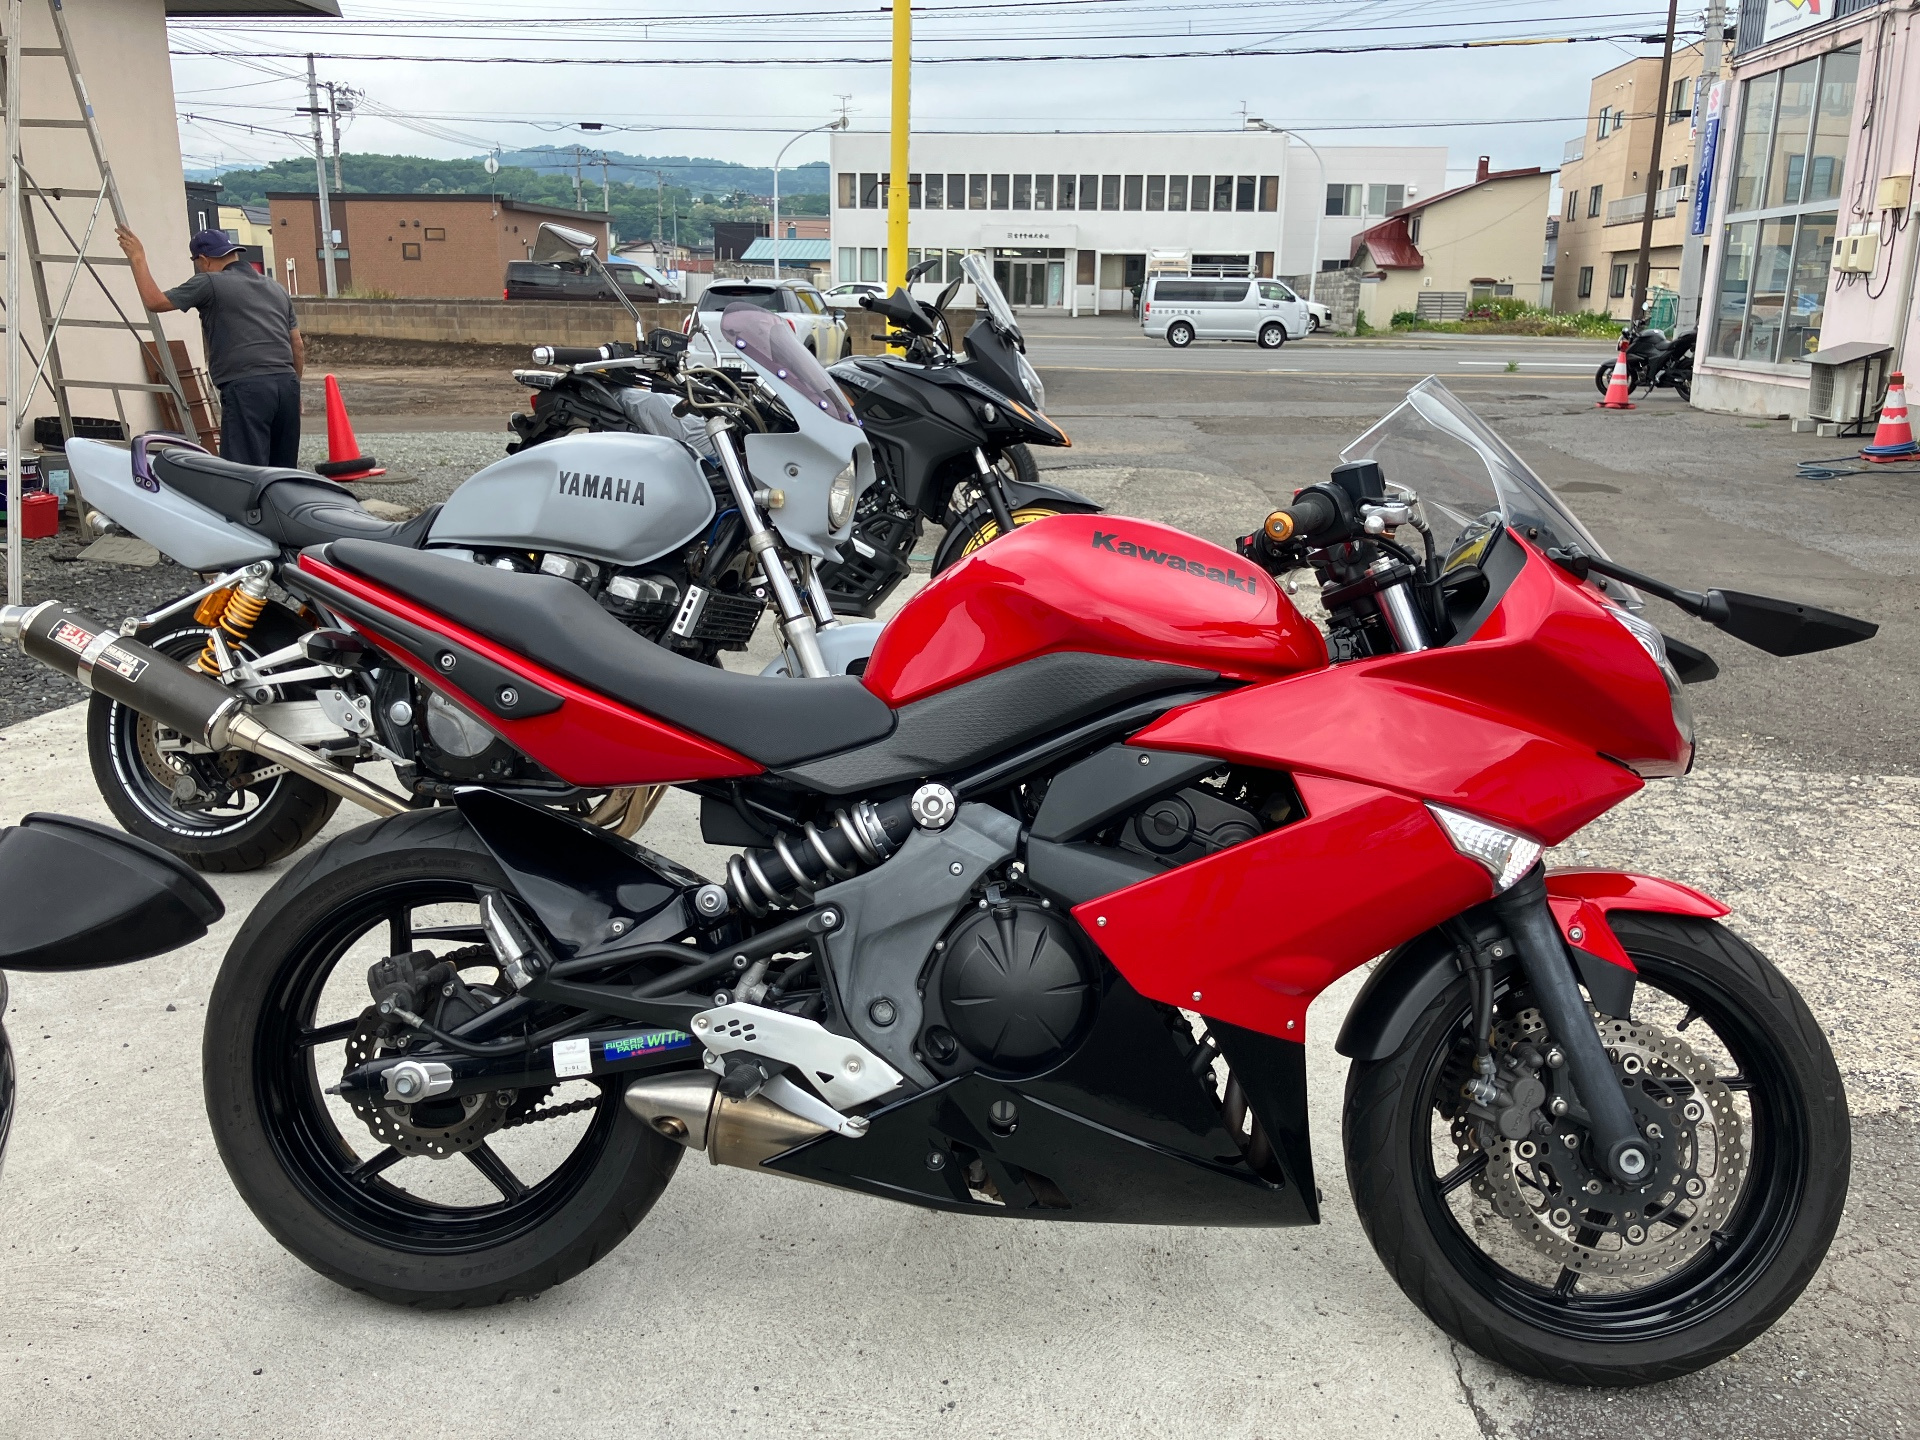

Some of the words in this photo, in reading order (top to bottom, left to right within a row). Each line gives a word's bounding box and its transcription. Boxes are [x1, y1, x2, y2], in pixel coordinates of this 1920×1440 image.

[1694, 122, 1713, 232] スズキバイクショップ
[559, 470, 645, 506] YAMAHA
[1091, 530, 1257, 596] Kawasaki
[605, 1036, 644, 1050] RIDERS
[617, 1042, 645, 1053] PARK
[646, 1029, 686, 1047] WITH
